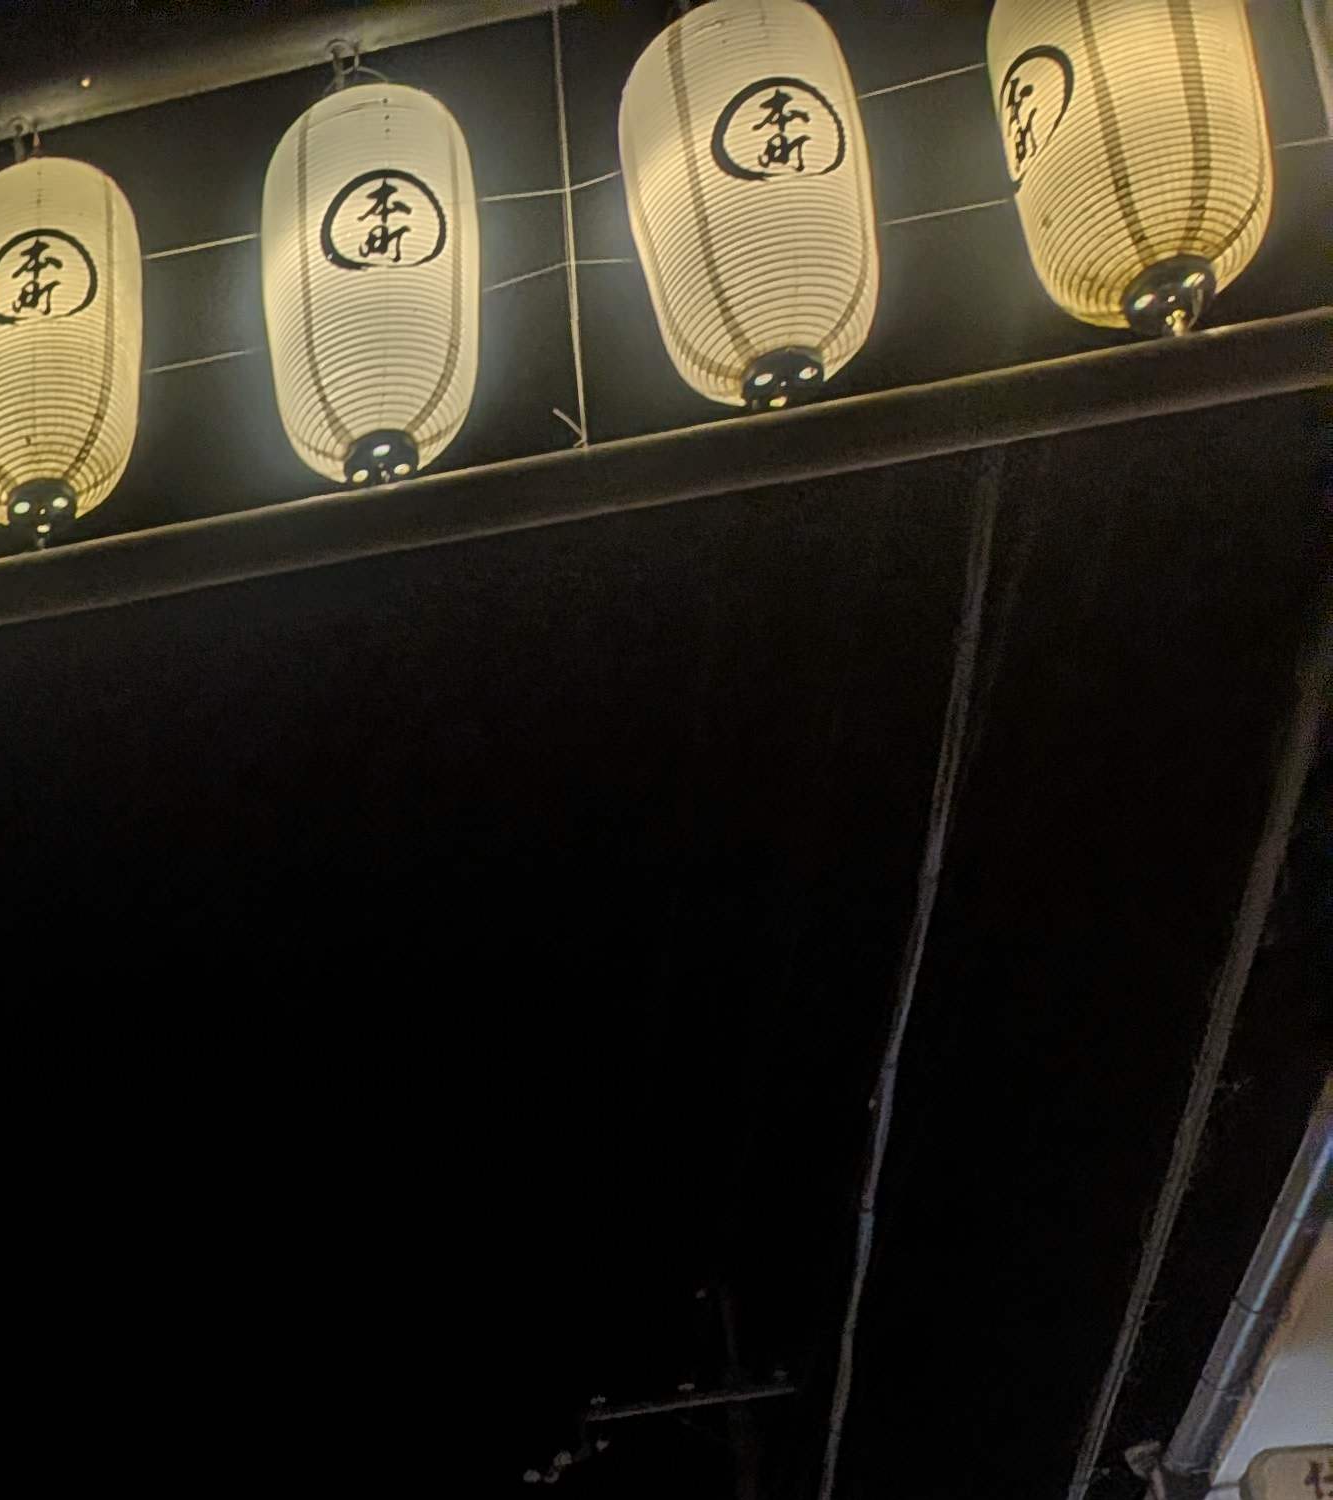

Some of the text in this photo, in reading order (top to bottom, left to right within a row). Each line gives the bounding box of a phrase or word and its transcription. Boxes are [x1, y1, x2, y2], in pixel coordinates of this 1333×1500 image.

[753, 89, 810, 173] 本町
[359, 178, 413, 263] 本町
[11, 239, 62, 316] 本町
